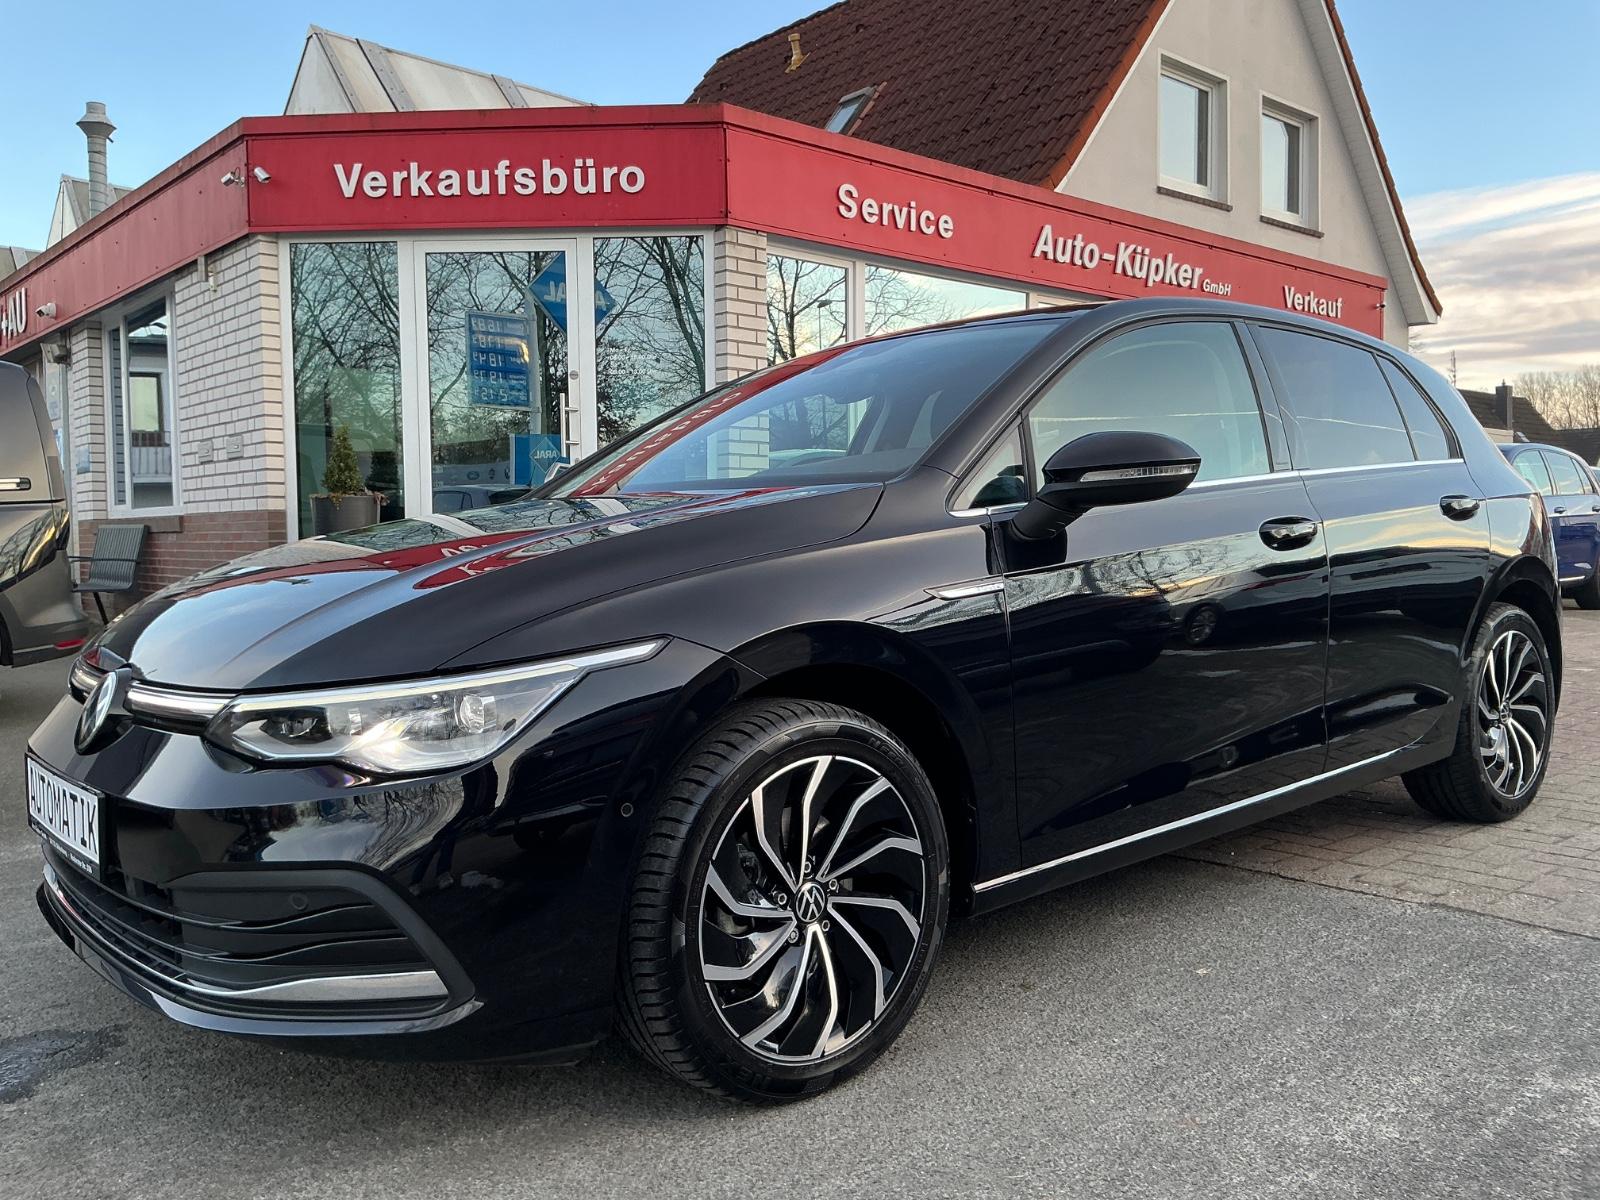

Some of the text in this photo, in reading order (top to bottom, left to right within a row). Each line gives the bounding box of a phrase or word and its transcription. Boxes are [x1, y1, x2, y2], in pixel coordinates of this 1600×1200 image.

[333, 158, 646, 198] Verkaufsbüro
[837, 183, 955, 239] Service
[1032, 224, 1232, 297] Auto-Küpker GmbH
[1283, 285, 1344, 319] Verkauf
[29, 765, 98, 854] AUTOMATIK
